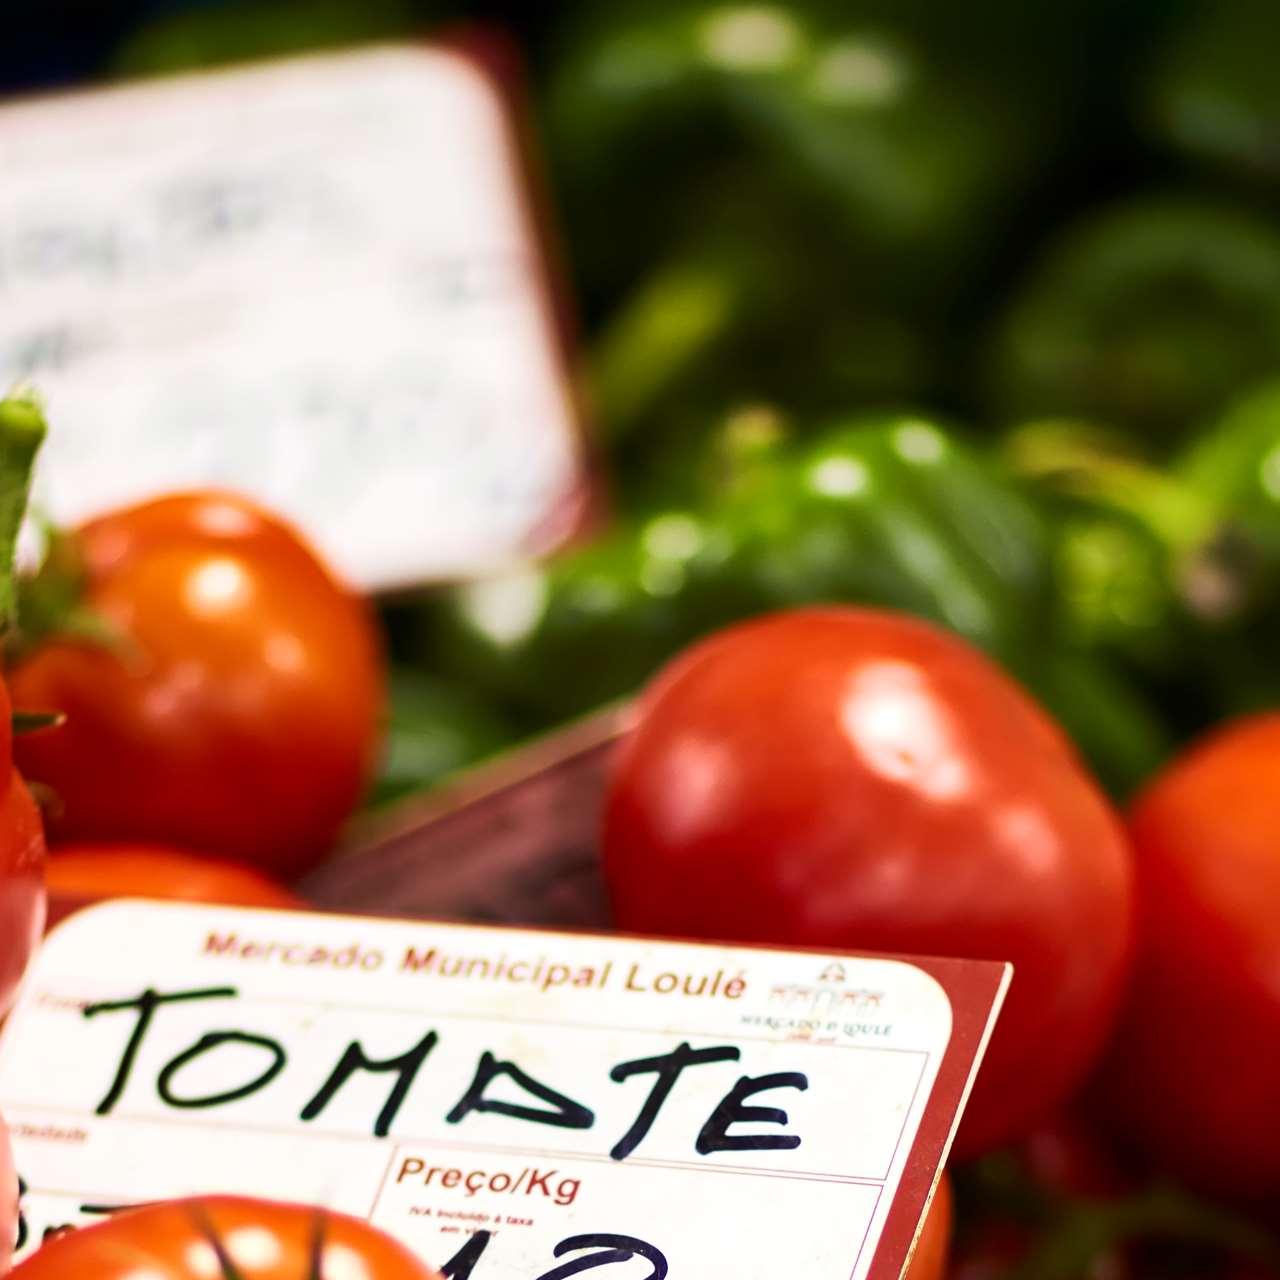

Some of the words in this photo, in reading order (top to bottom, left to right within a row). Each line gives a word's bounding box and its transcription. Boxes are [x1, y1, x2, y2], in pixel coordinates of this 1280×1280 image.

[202, 930, 384, 973] Mercado
[401, 943, 612, 993] Municipal
[623, 962, 748, 1001] Loulé
[82, 986, 810, 1161] TOMATE
[396, 1156, 582, 1206] Preço/Kg
